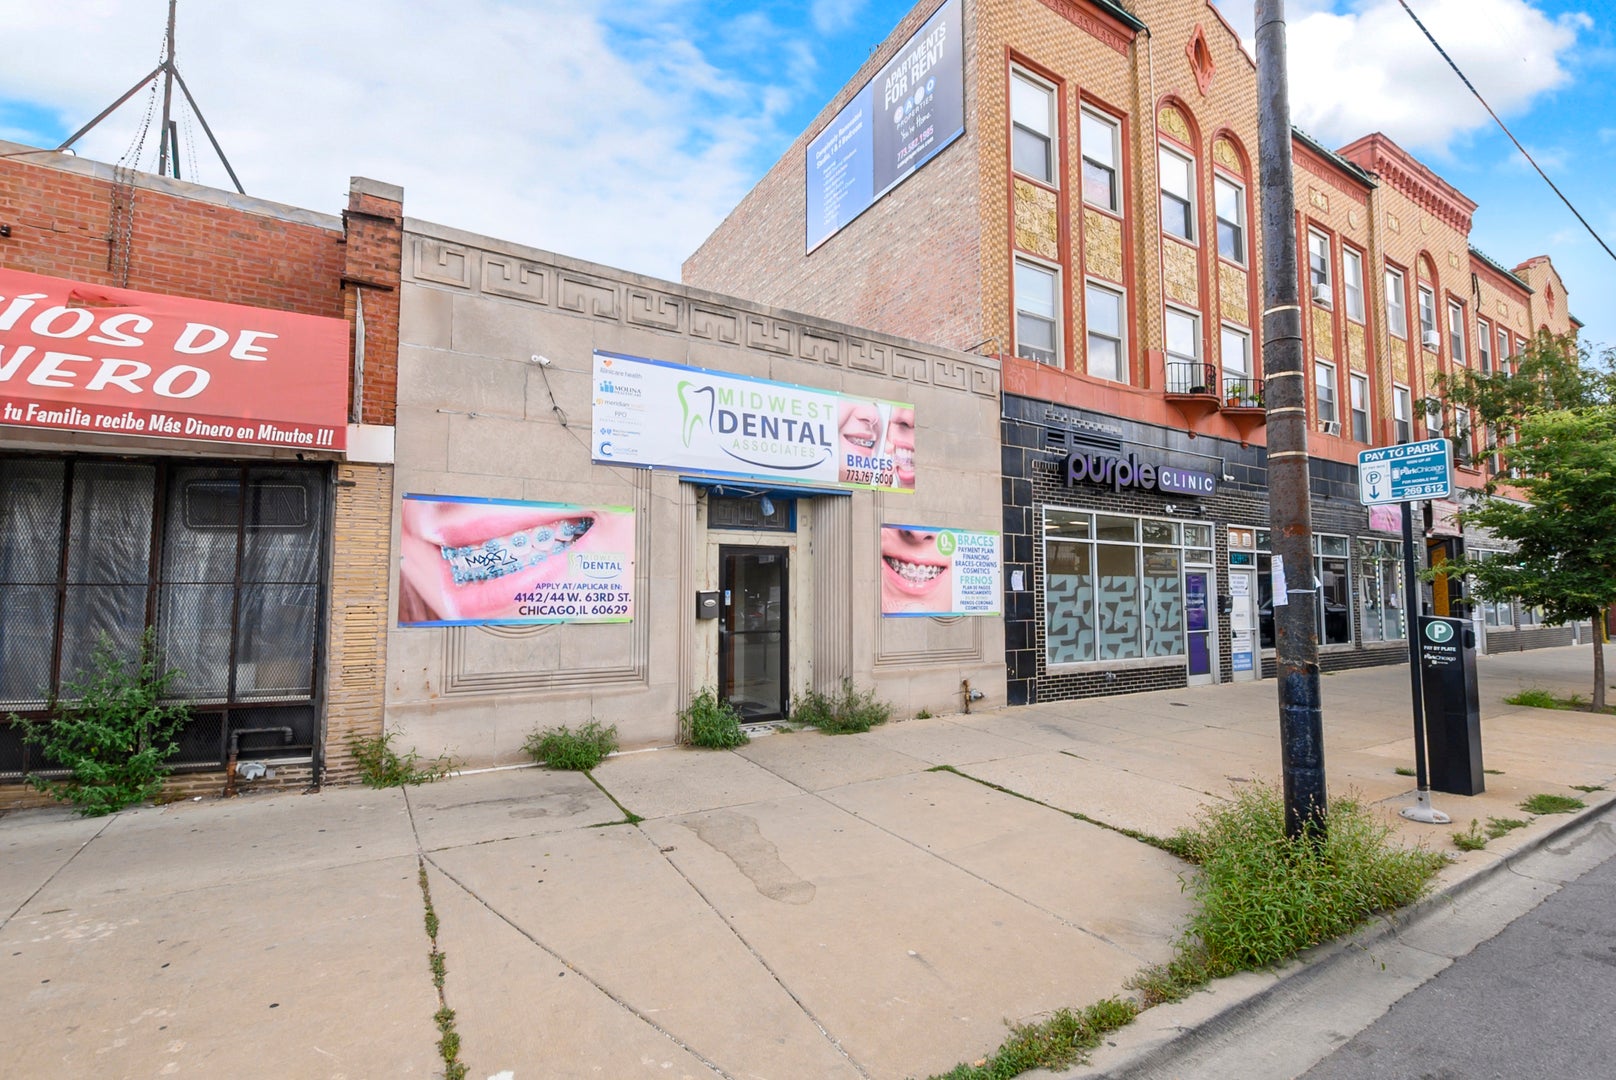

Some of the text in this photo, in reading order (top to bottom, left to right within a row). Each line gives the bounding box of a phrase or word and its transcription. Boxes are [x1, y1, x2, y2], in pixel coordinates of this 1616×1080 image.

[885, 21, 947, 93] APARTMENTS
[884, 35, 946, 111] FOR RENT
[896, 93, 934, 130] PROPERTIES
[0, 292, 279, 361] ÍOS DE
[614, 384, 642, 395] MOLINA
[718, 387, 833, 420] MIDWEST
[4, 402, 334, 446] tu Familia recibe Más Dinero en Minutos !!!
[718, 409, 832, 447] DENTAL
[732, 439, 816, 458] ASSOCIATES
[1364, 442, 1440, 462] PAY TO PARK
[847, 454, 893, 471] BRACES
[1400, 464, 1445, 476] ParkChicago
[846, 469, 894, 485] 773.767.6000
[1066, 452, 1213, 493] purple CLINIC
[1404, 486, 1422, 496] 269
[1424, 484, 1444, 494] 612
[958, 535, 994, 547] BRACES
[582, 561, 622, 570] DENTAL
[955, 560, 998, 568] BRACES-CROWNS
[960, 575, 993, 584] FRENOS
[514, 592, 632, 603] 4142/44 W. 63RD ST.
[518, 605, 628, 616] CHICAGO,IL 60629
[1434, 624, 1446, 639] P
